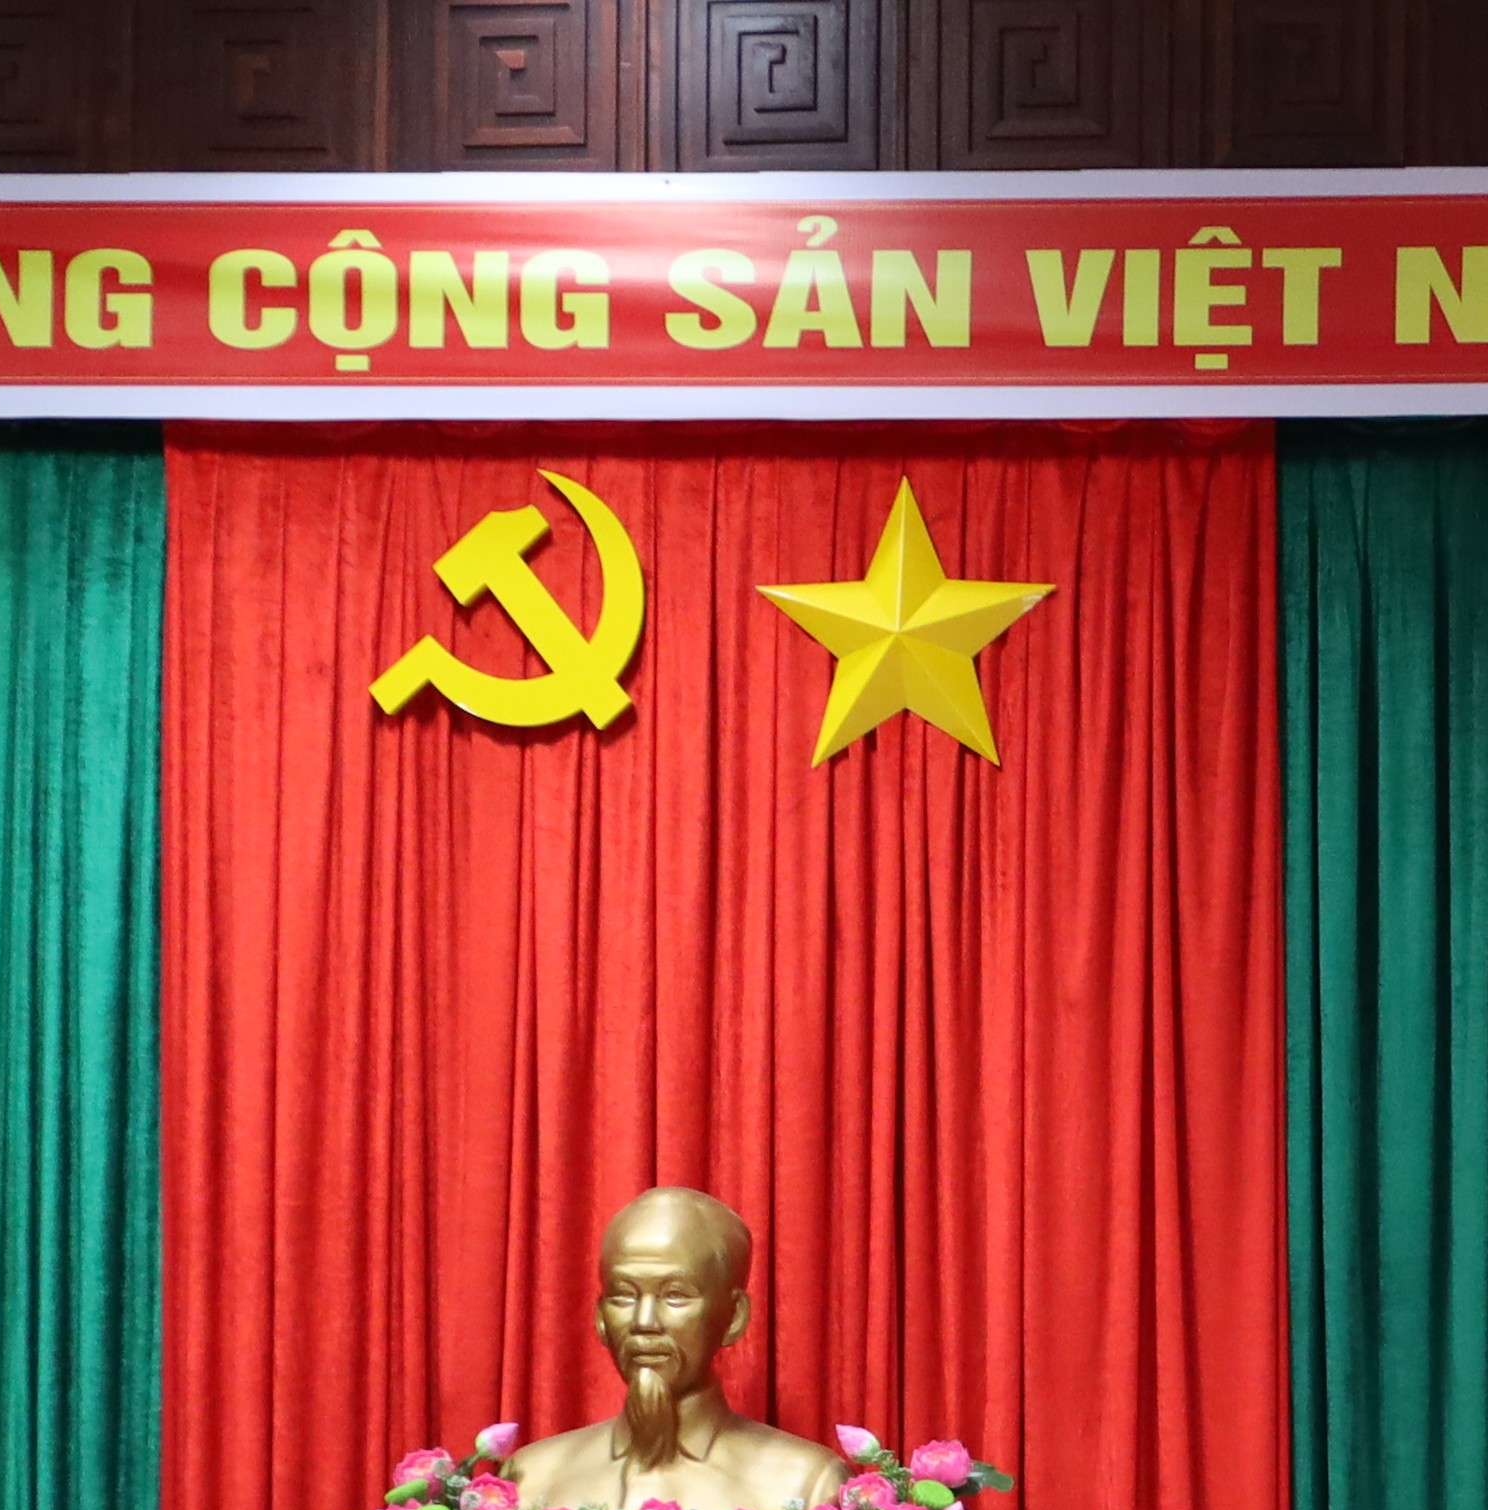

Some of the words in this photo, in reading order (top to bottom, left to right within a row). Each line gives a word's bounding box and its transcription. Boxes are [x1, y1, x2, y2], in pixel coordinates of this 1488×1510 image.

[209, 229, 610, 372] CỘNG
[666, 215, 972, 349] SẢN
[1026, 227, 1342, 371] VIỆT
